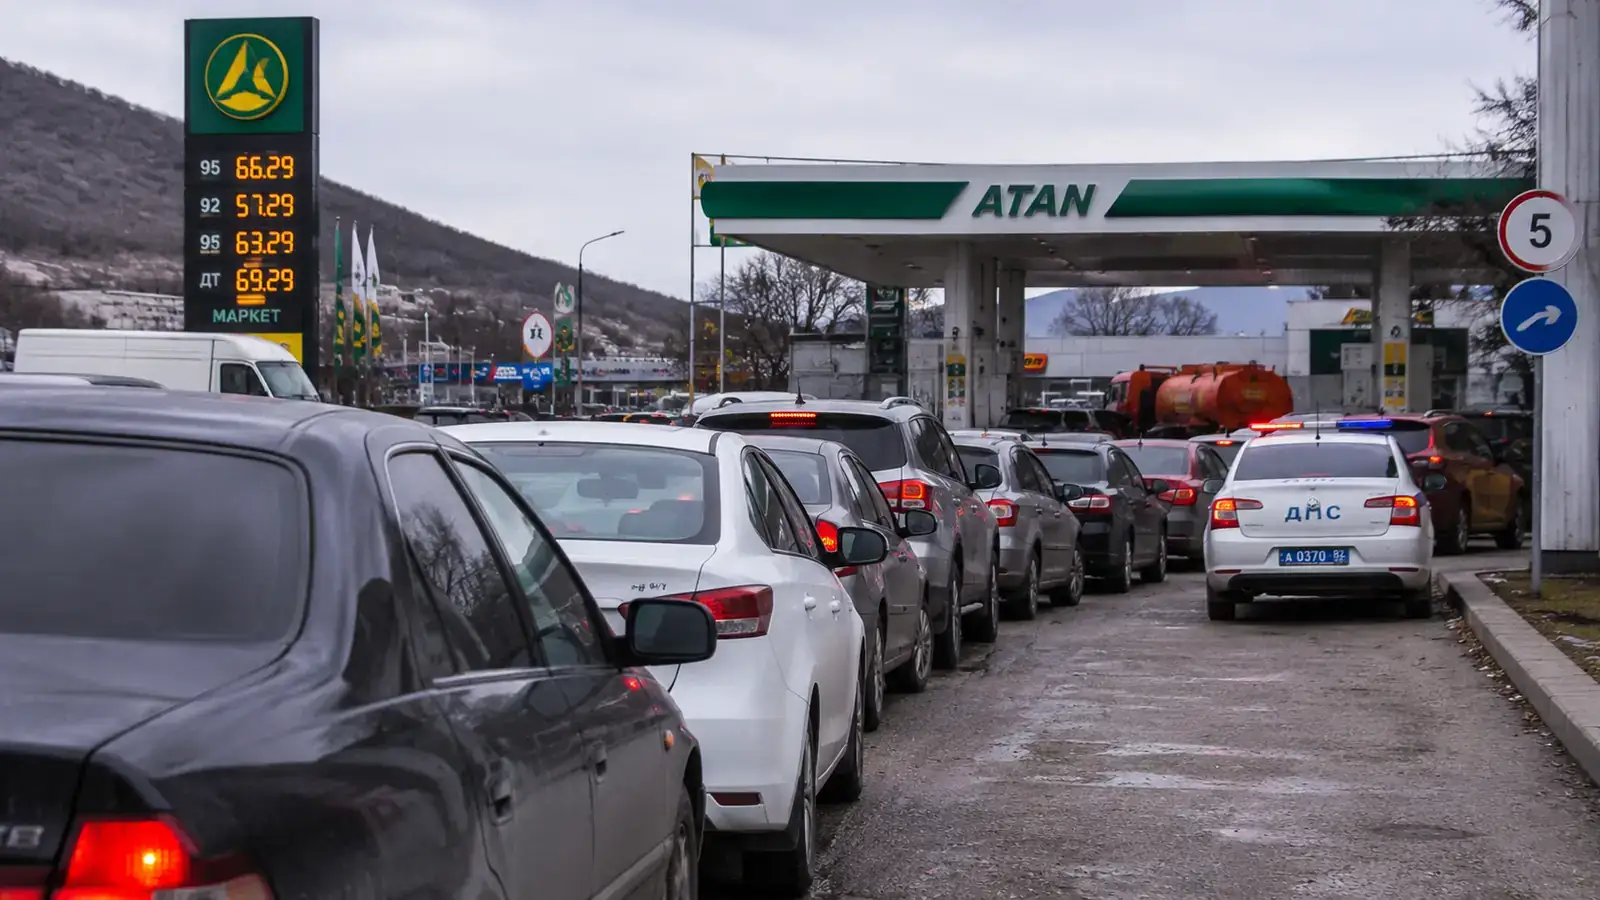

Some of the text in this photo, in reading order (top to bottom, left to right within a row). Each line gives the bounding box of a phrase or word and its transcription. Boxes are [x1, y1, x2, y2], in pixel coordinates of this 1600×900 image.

[200, 156, 294, 179] 95 66.29
[200, 194, 294, 217] 92 57.29
[971, 184, 1096, 217] ATAN
[1529, 213, 1552, 248] 5
[200, 231, 294, 254] 95 63.29
[199, 268, 294, 292] ДТ 69.29
[212, 309, 282, 323] МАРКЕТ
[1284, 505, 1341, 523] ДПС
